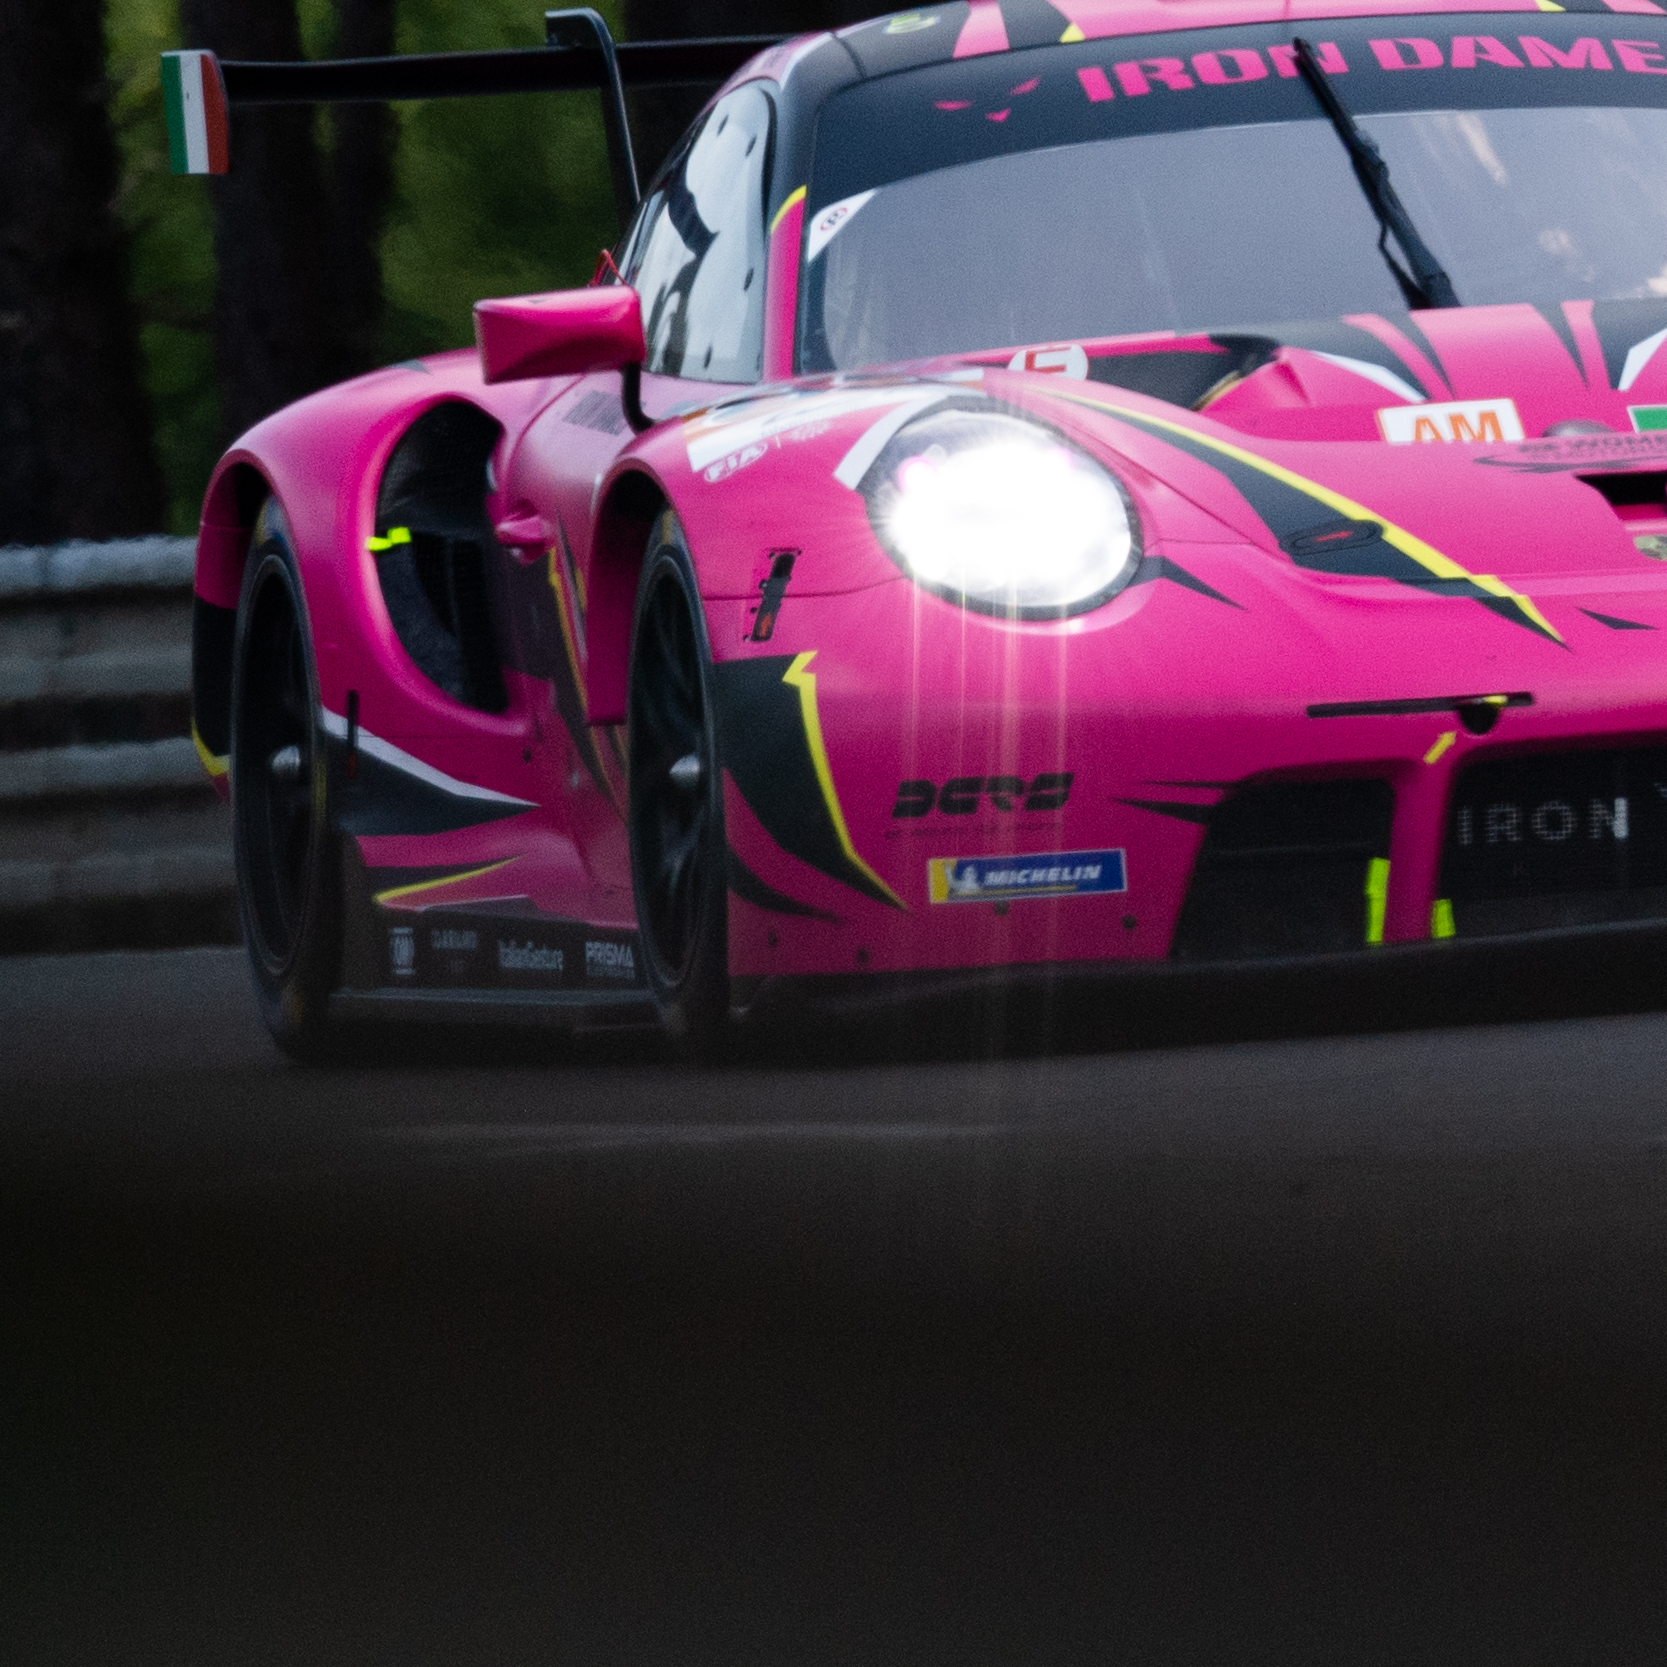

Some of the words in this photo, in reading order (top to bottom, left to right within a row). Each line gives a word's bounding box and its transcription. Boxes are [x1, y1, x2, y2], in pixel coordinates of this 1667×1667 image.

[1077, 42, 1349, 103] IRON
[1414, 409, 1504, 442] AM
[1457, 797, 1630, 846] IRON
[983, 864, 1102, 887] MICHELIN
[584, 940, 635, 969] PRISMA
